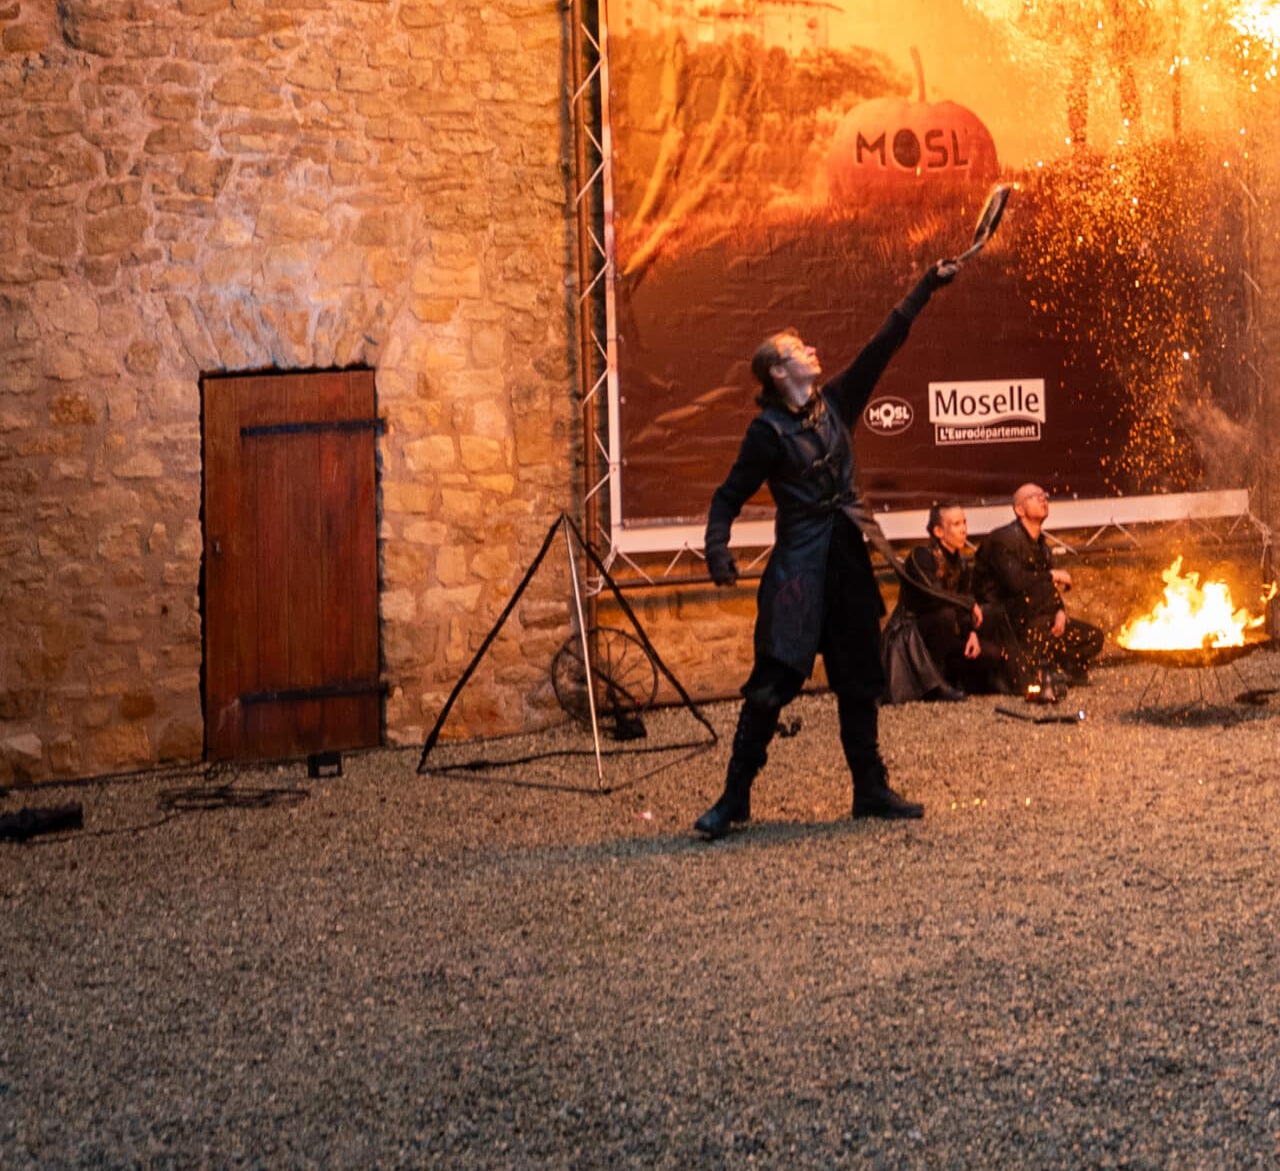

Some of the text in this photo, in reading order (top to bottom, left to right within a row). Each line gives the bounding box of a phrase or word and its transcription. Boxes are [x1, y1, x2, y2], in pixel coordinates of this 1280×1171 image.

[855, 127, 970, 169] MOSL
[869, 403, 910, 426] MOSL
[935, 384, 1040, 417] Moselle
[939, 425, 1036, 441] L'Eurodépartement
